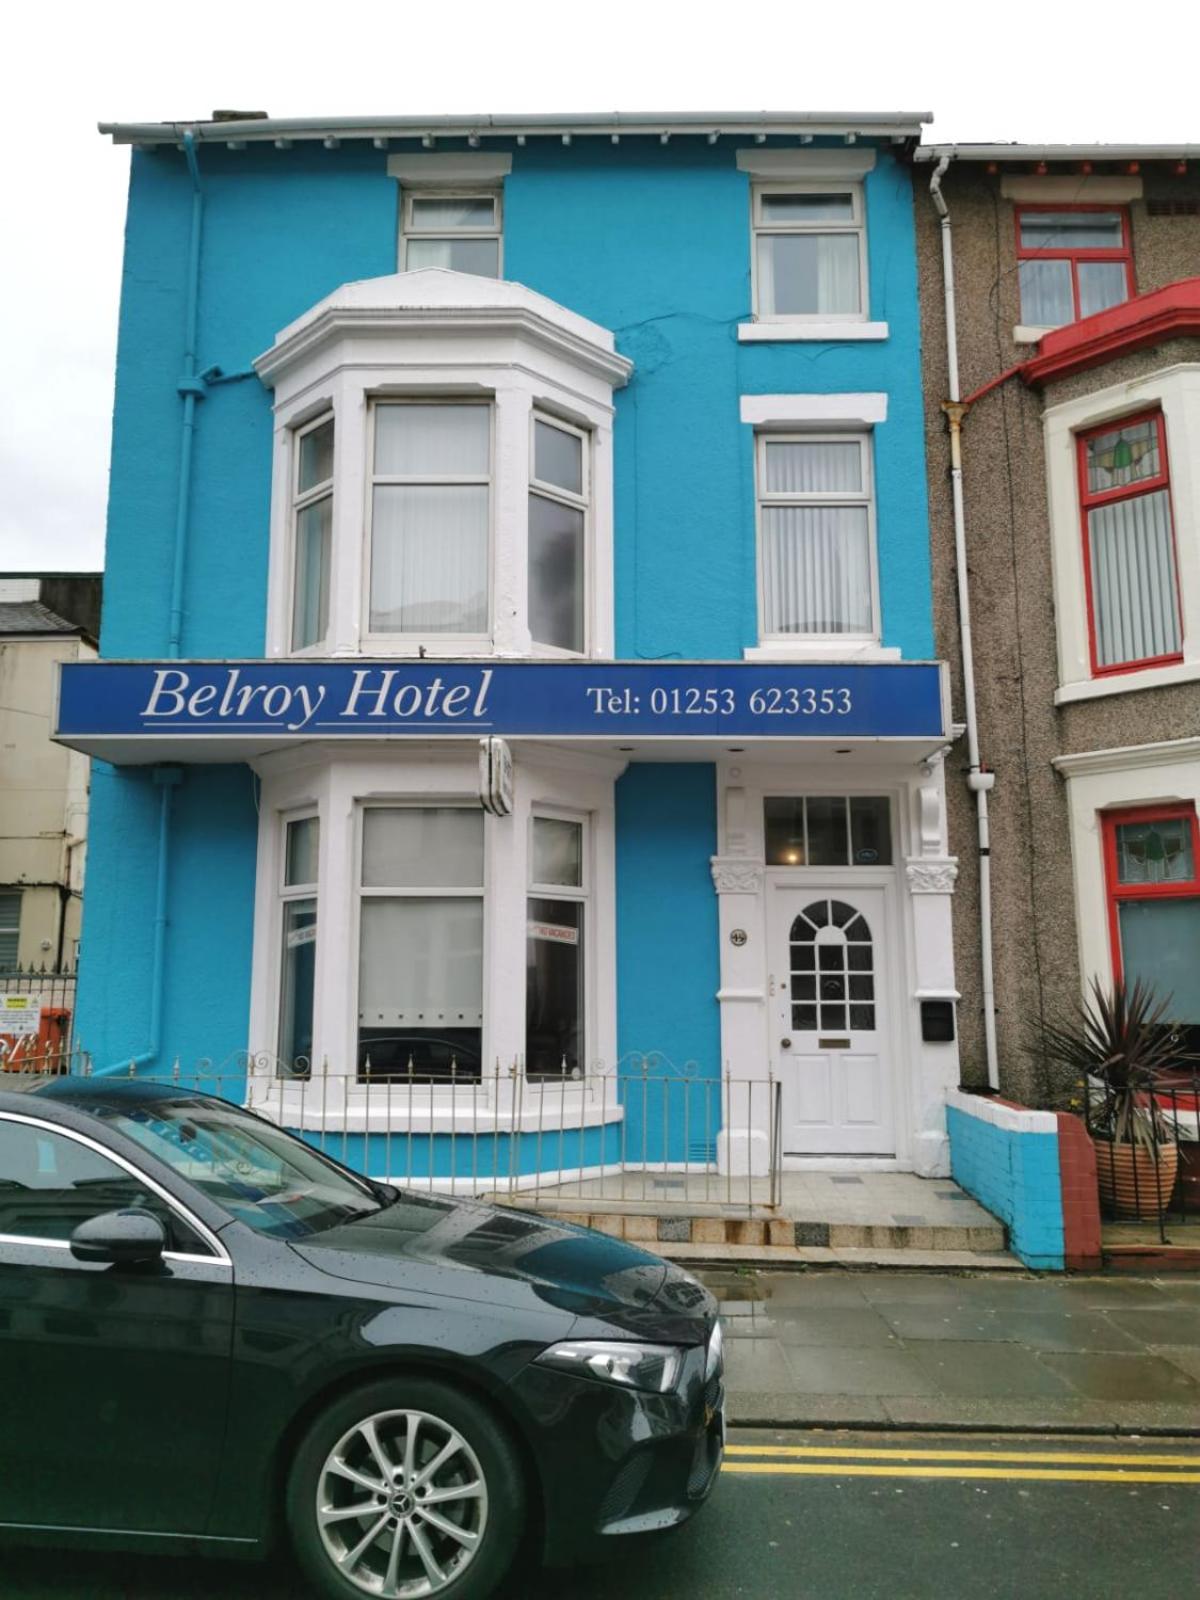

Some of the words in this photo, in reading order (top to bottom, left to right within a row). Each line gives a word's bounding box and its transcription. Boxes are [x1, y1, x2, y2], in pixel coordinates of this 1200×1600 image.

[140, 670, 326, 731] Belroy
[340, 670, 493, 717] Hotel
[586, 688, 641, 714] Tel:
[649, 688, 735, 714] 01253
[749, 688, 853, 714] 623353
